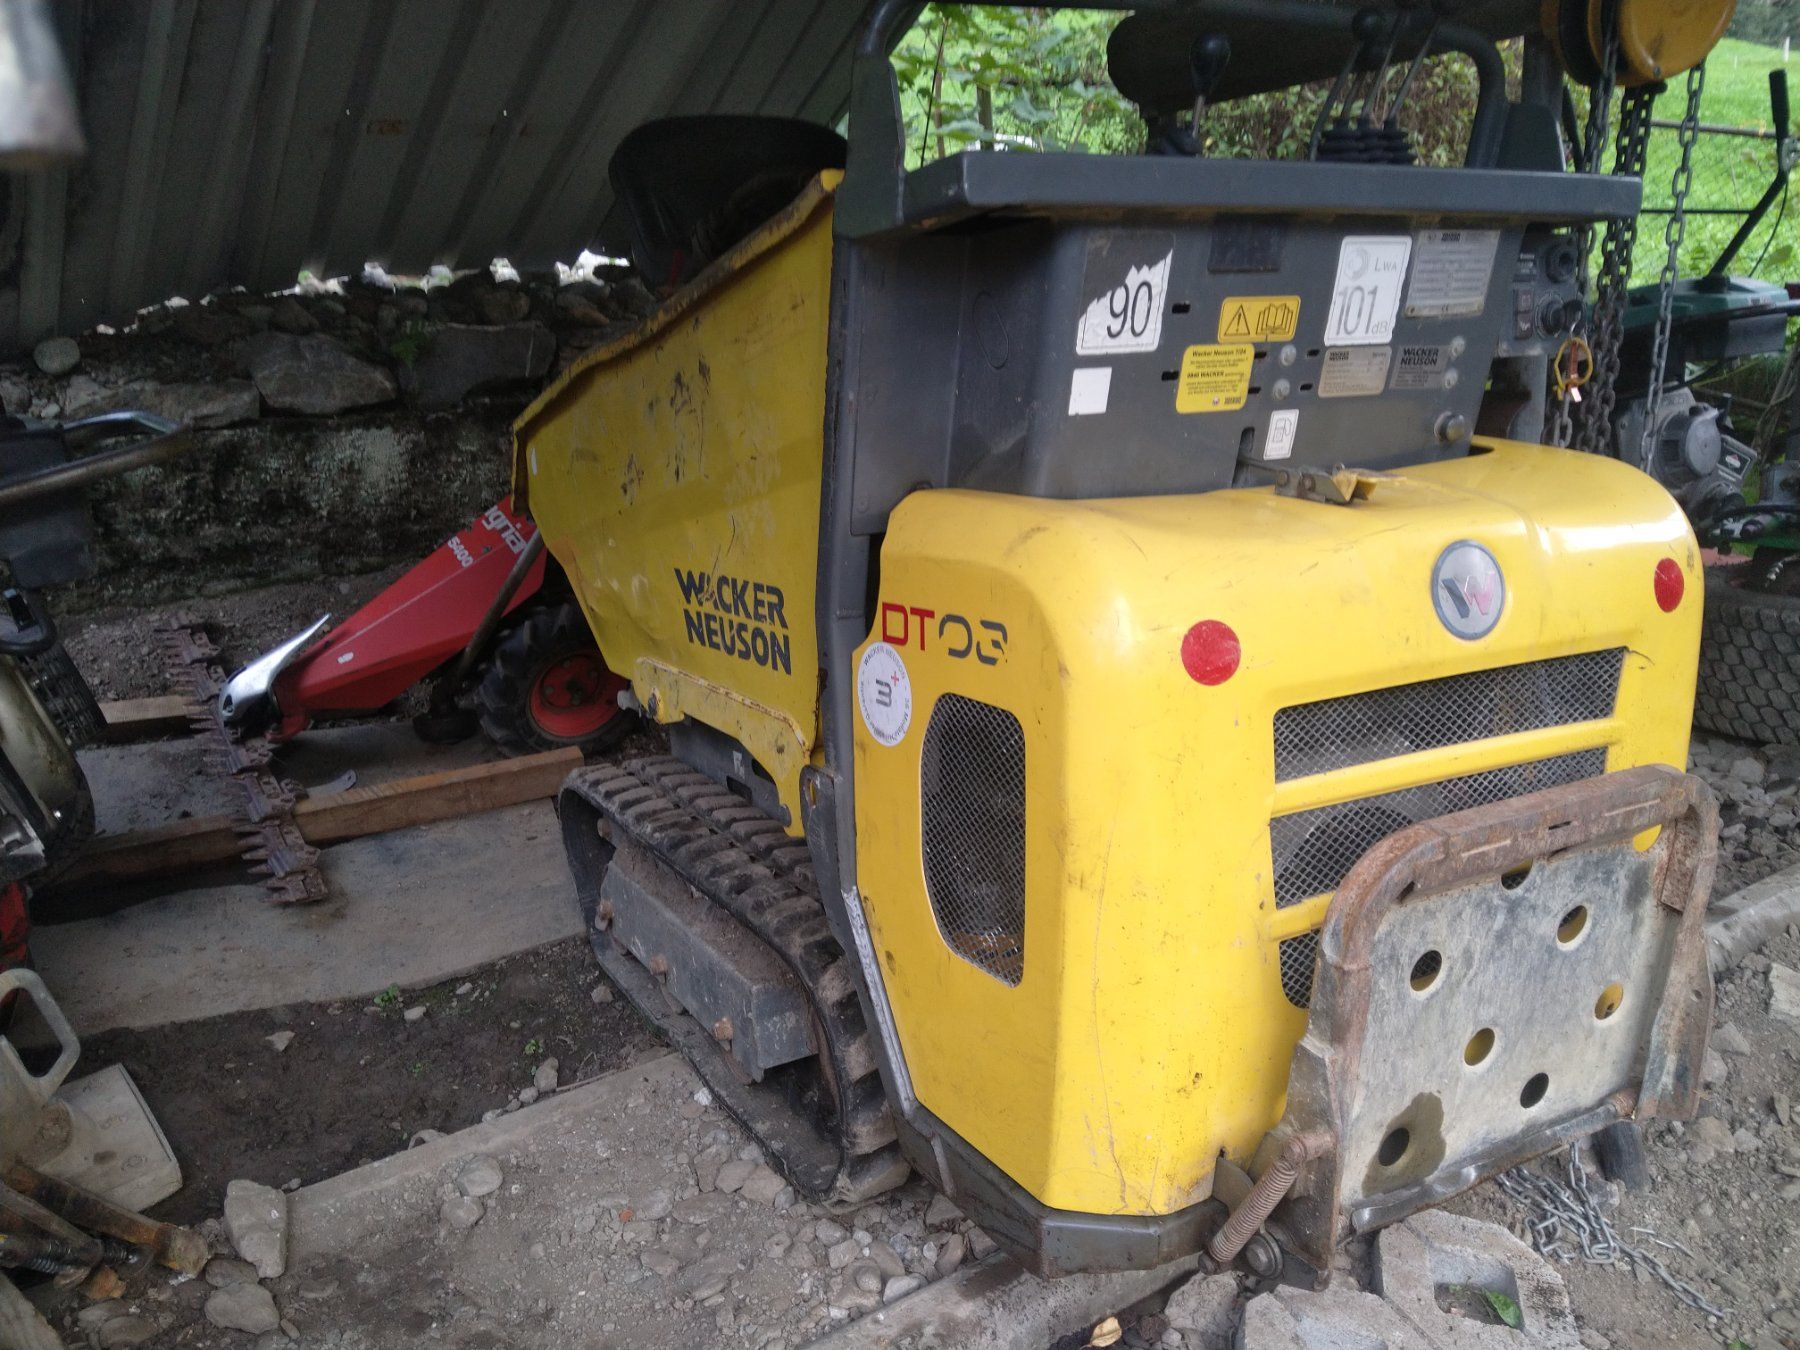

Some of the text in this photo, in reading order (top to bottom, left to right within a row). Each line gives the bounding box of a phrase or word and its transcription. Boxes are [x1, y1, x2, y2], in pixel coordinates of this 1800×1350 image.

[1106, 281, 1153, 339] 90
[1335, 285, 1388, 336] 101 dB
[1192, 349, 1213, 357] Wacker
[1213, 348, 1235, 357] Neuson
[1400, 356, 1438, 366] NEUSON
[1200, 370, 1225, 378] WACKER
[447, 535, 474, 569] 5400
[683, 608, 792, 676] NEUSON
[863, 645, 885, 666] WACKER
[885, 646, 905, 680] NEUSON
